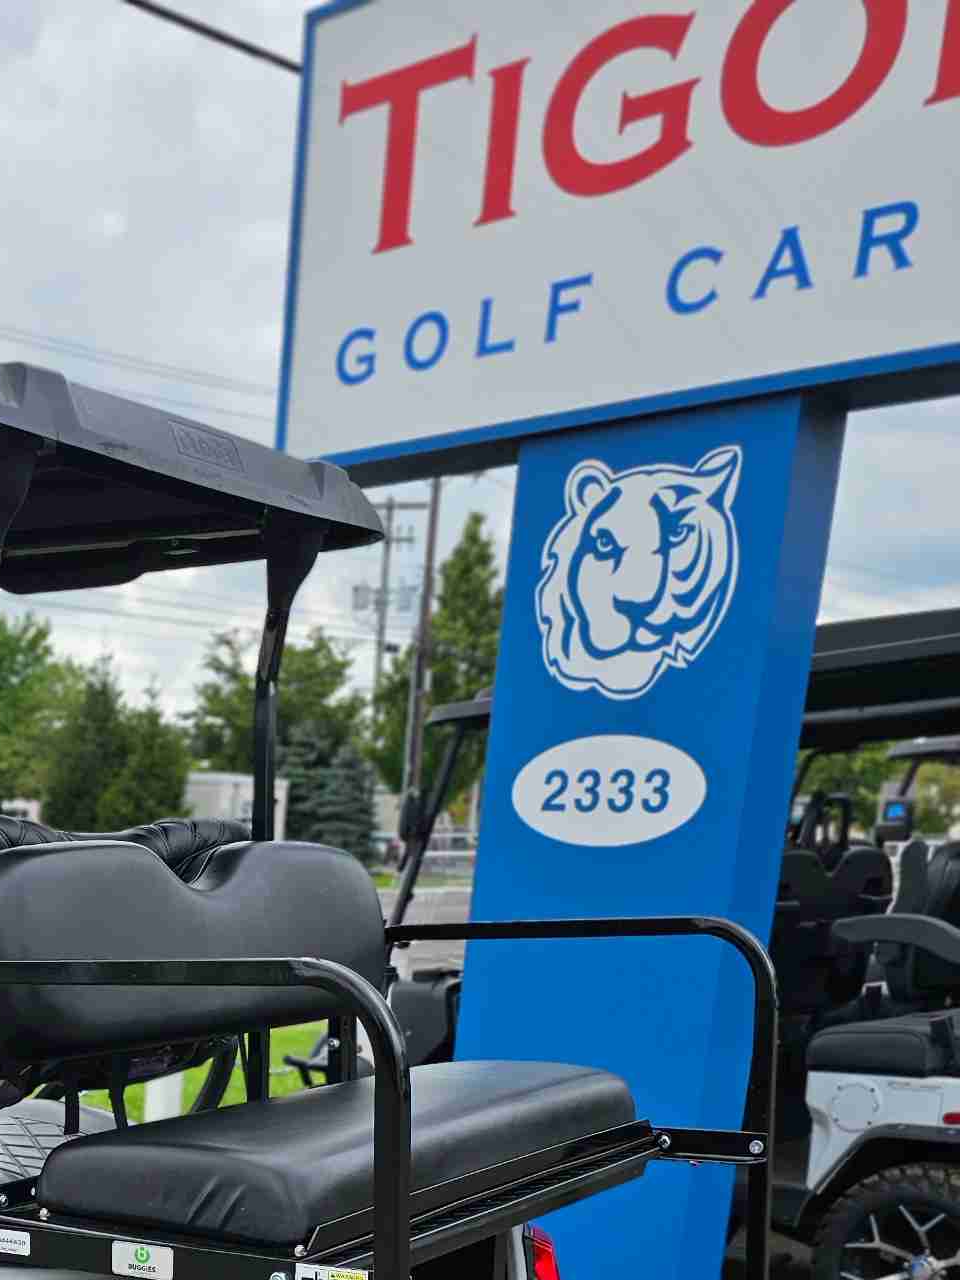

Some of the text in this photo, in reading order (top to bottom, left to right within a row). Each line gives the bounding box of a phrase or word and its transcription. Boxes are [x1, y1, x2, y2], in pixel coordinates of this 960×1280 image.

[338, 0, 960, 255] TIGO
[335, 273, 593, 386] GOLF
[541, 768, 671, 814] 2333
